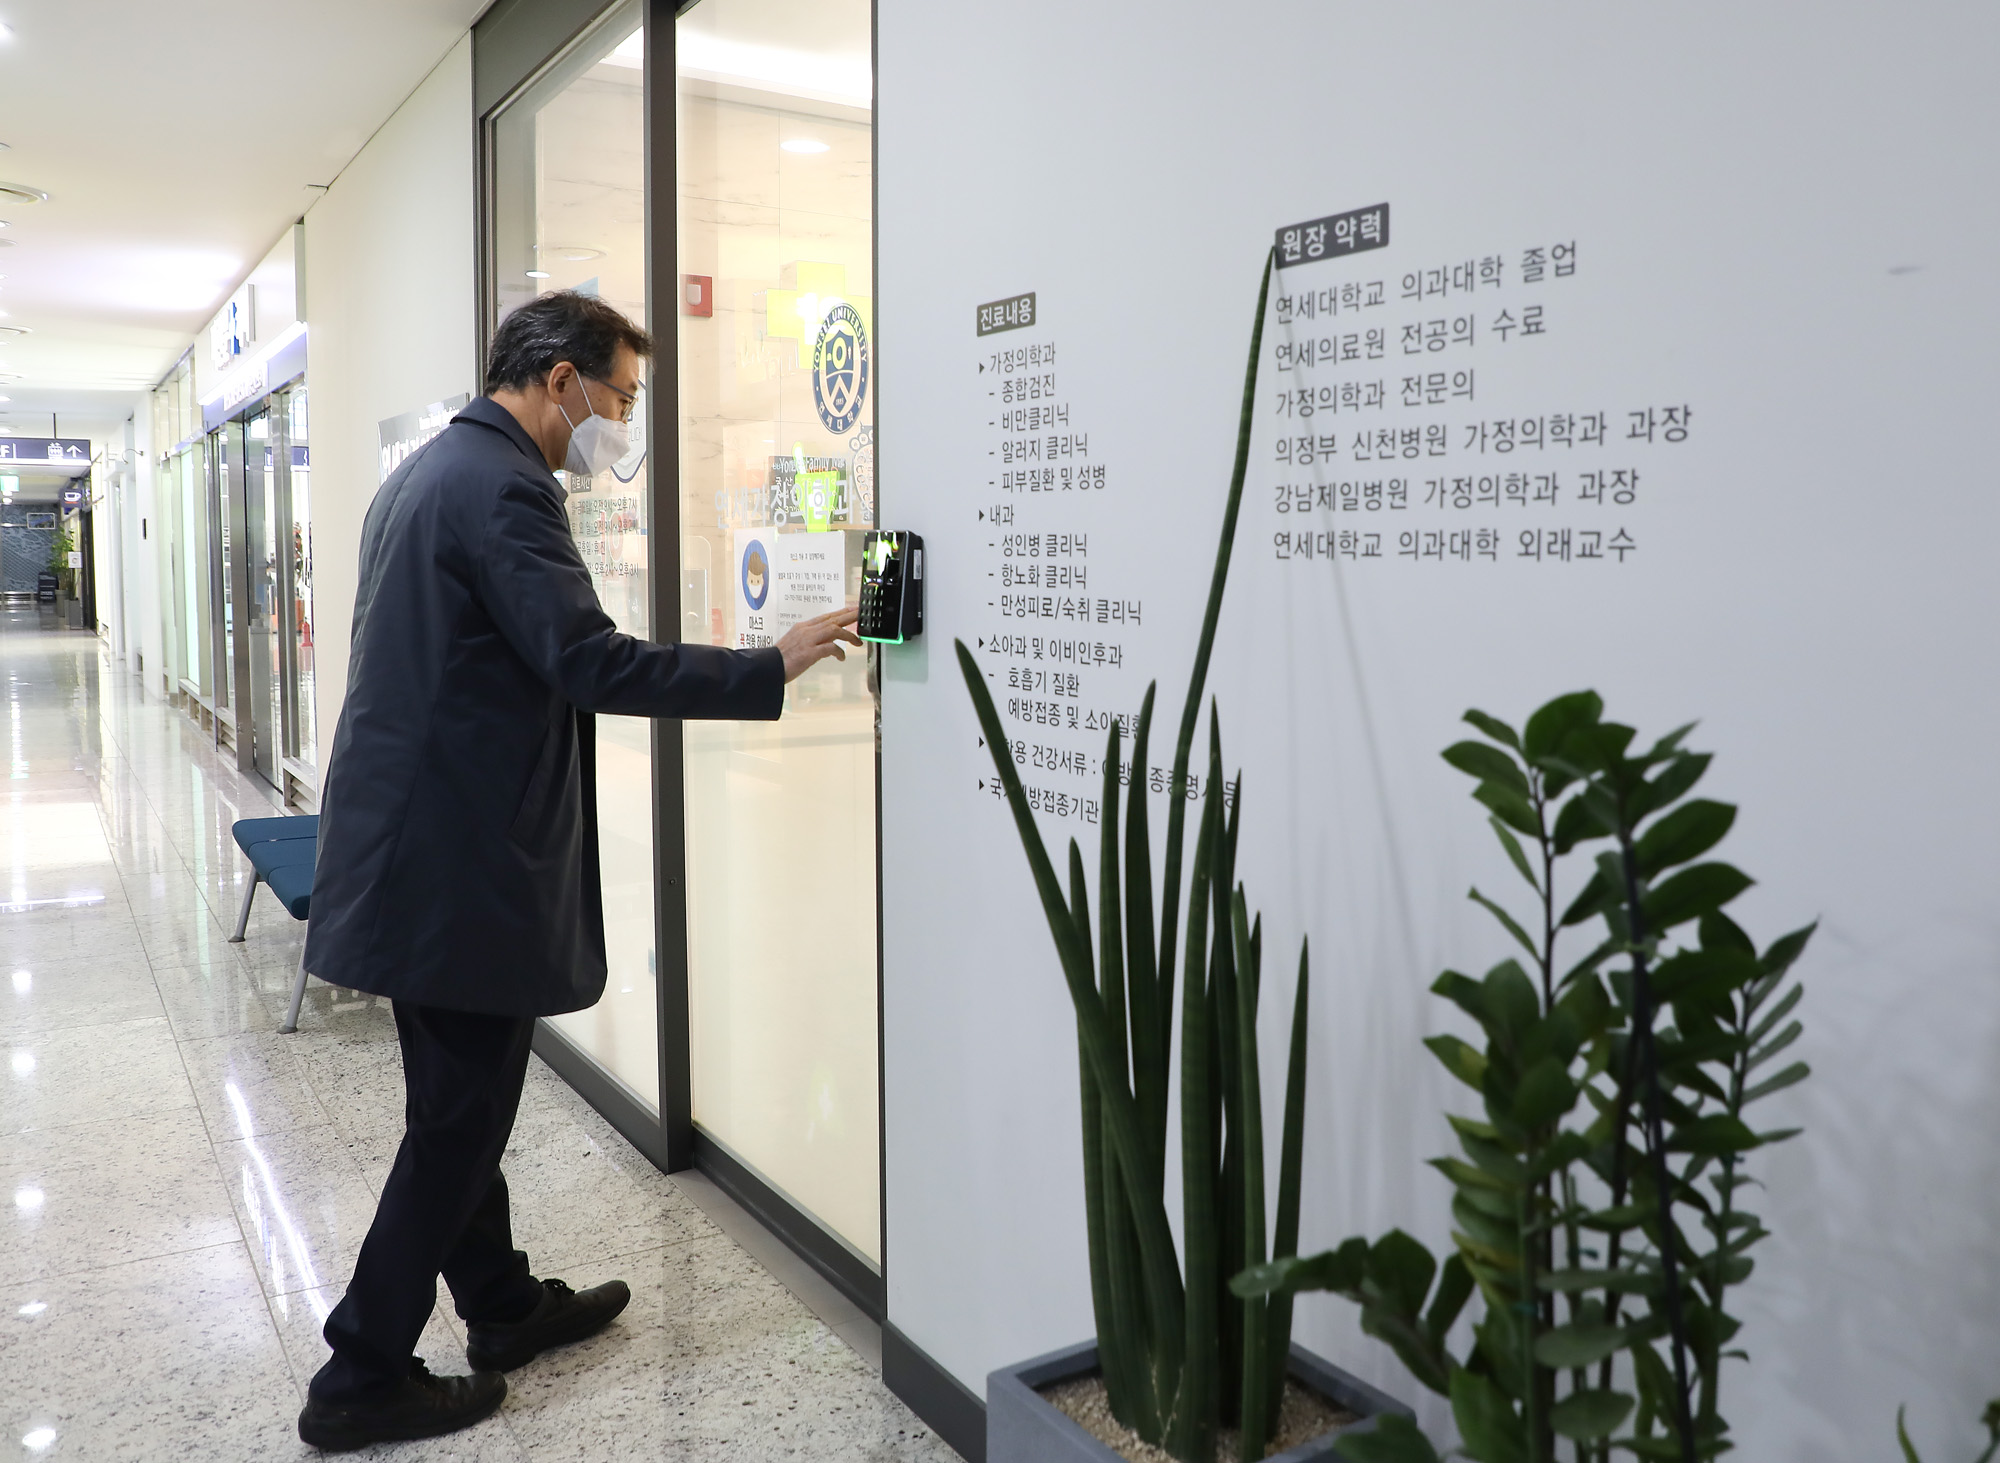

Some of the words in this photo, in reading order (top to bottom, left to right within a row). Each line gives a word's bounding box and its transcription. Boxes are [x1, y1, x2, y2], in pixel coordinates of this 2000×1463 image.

[1281, 225, 1327, 261] 원장
[1334, 209, 1381, 249] 약력
[1276, 281, 1385, 324] 연세대학교
[1401, 255, 1504, 301] 의과대학
[1521, 241, 1575, 283] 졸업
[980, 298, 1032, 331] 진료내용
[830, 306, 867, 362] UNIVERSITY
[1276, 328, 1384, 372] 연세의료원
[1401, 314, 1474, 355] 전공의
[1492, 305, 1546, 342] 수료
[991, 342, 1055, 376] 가정의학과
[1002, 372, 1054, 403] 종합검진
[1277, 380, 1385, 418] 가정의학과
[1401, 369, 1473, 406] 전문의
[1003, 401, 1068, 432] 비만클리닉
[1002, 438, 1040, 463] 알러지
[1046, 433, 1087, 459] 클리닉
[1276, 435, 1337, 465] 의정부
[1352, 425, 1446, 461] 신천병원
[1465, 411, 1607, 454] 가정의학과
[1626, 404, 1692, 443] 과장
[1002, 468, 1054, 493] 피부질환
[1061, 467, 1072, 490] 및
[1077, 464, 1105, 490] 성병
[1275, 479, 1407, 513] 강남제일병원
[1425, 472, 1559, 509] 가정의학과
[1578, 468, 1639, 505] 과장
[990, 504, 1014, 526] 내과
[1002, 534, 1039, 557] 성인병
[1046, 533, 1086, 557] 클리닉
[1274, 530, 1382, 560] 연세대학교
[1398, 528, 1500, 562] 의과대학
[1517, 527, 1636, 563] 외래교수
[1002, 564, 1040, 587] 항노화
[1045, 566, 1086, 590] 클리닉
[1002, 594, 1089, 622] 만성피로/숙취
[1096, 599, 1141, 626] 클리닉
[989, 634, 1027, 658] 소아과
[1032, 638, 1043, 660] 및
[1050, 639, 1123, 669] 이비인후과
[1008, 667, 1046, 693] 호흡기
[1053, 673, 1079, 698] 질환
[1008, 698, 1061, 726] 예방접종
[1067, 706, 1078, 730] 및
[1032, 745, 1087, 776] 건강서류
[990, 777, 1098, 824] 국방접종기관
